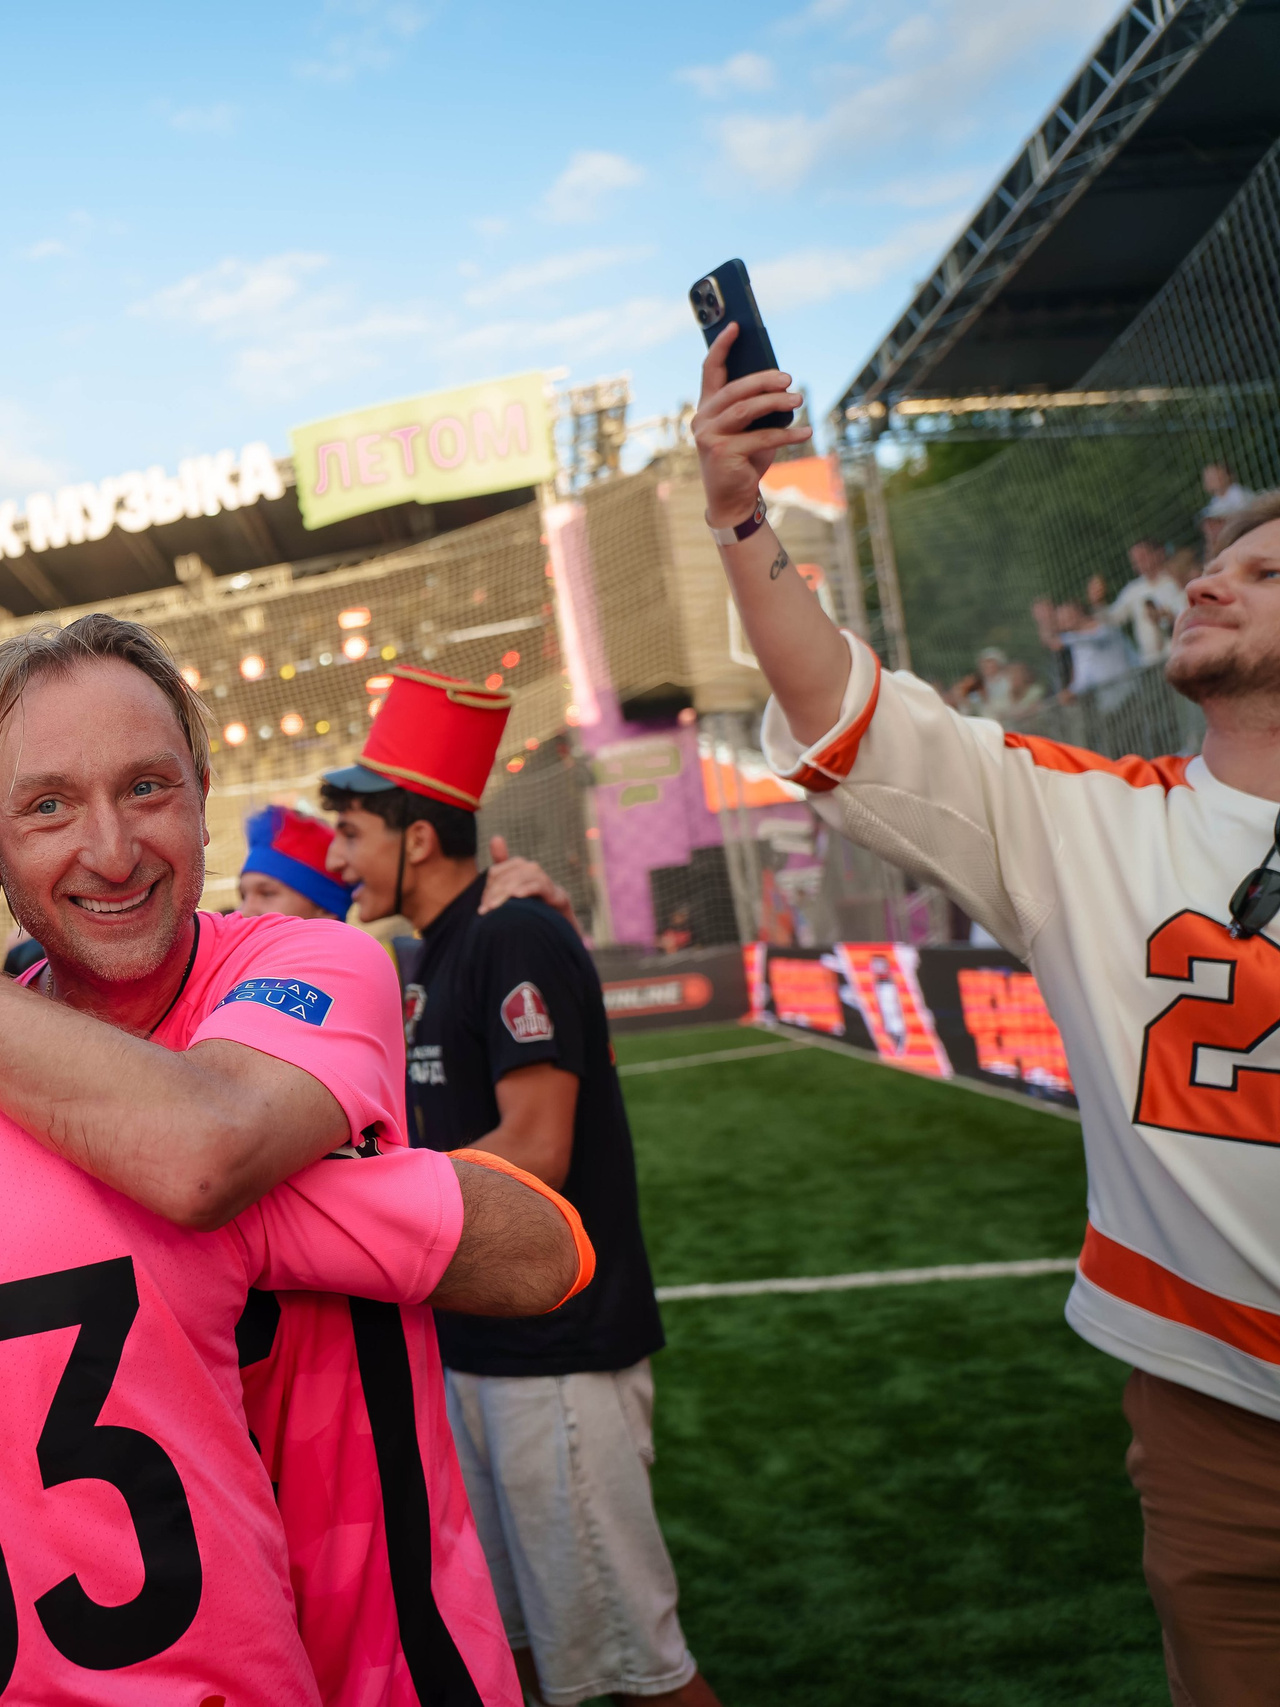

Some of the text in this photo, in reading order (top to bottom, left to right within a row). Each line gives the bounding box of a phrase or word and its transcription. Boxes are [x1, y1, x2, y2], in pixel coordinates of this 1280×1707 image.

[314, 403, 530, 495] ЛЕТОМ
[24, 440, 287, 553] МУЗЫКА
[232, 981, 318, 1004] TELLAR
